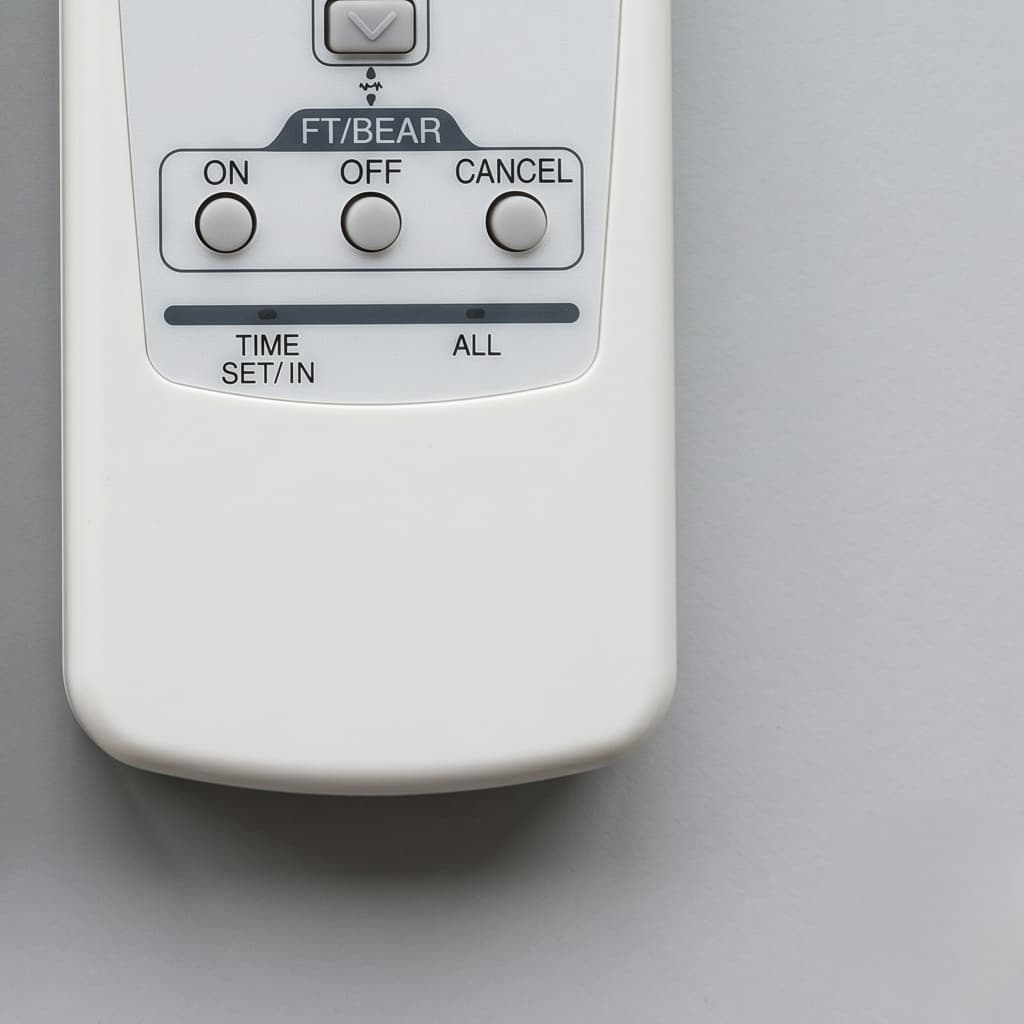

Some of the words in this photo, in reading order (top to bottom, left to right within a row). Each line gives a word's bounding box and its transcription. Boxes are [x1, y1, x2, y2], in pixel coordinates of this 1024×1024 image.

[302, 118, 440, 144] FT/BEAR
[204, 160, 248, 185] ON
[341, 159, 402, 185] OFF
[456, 157, 573, 184] CANCEL
[236, 335, 298, 356] TIME
[453, 334, 501, 356] ALL
